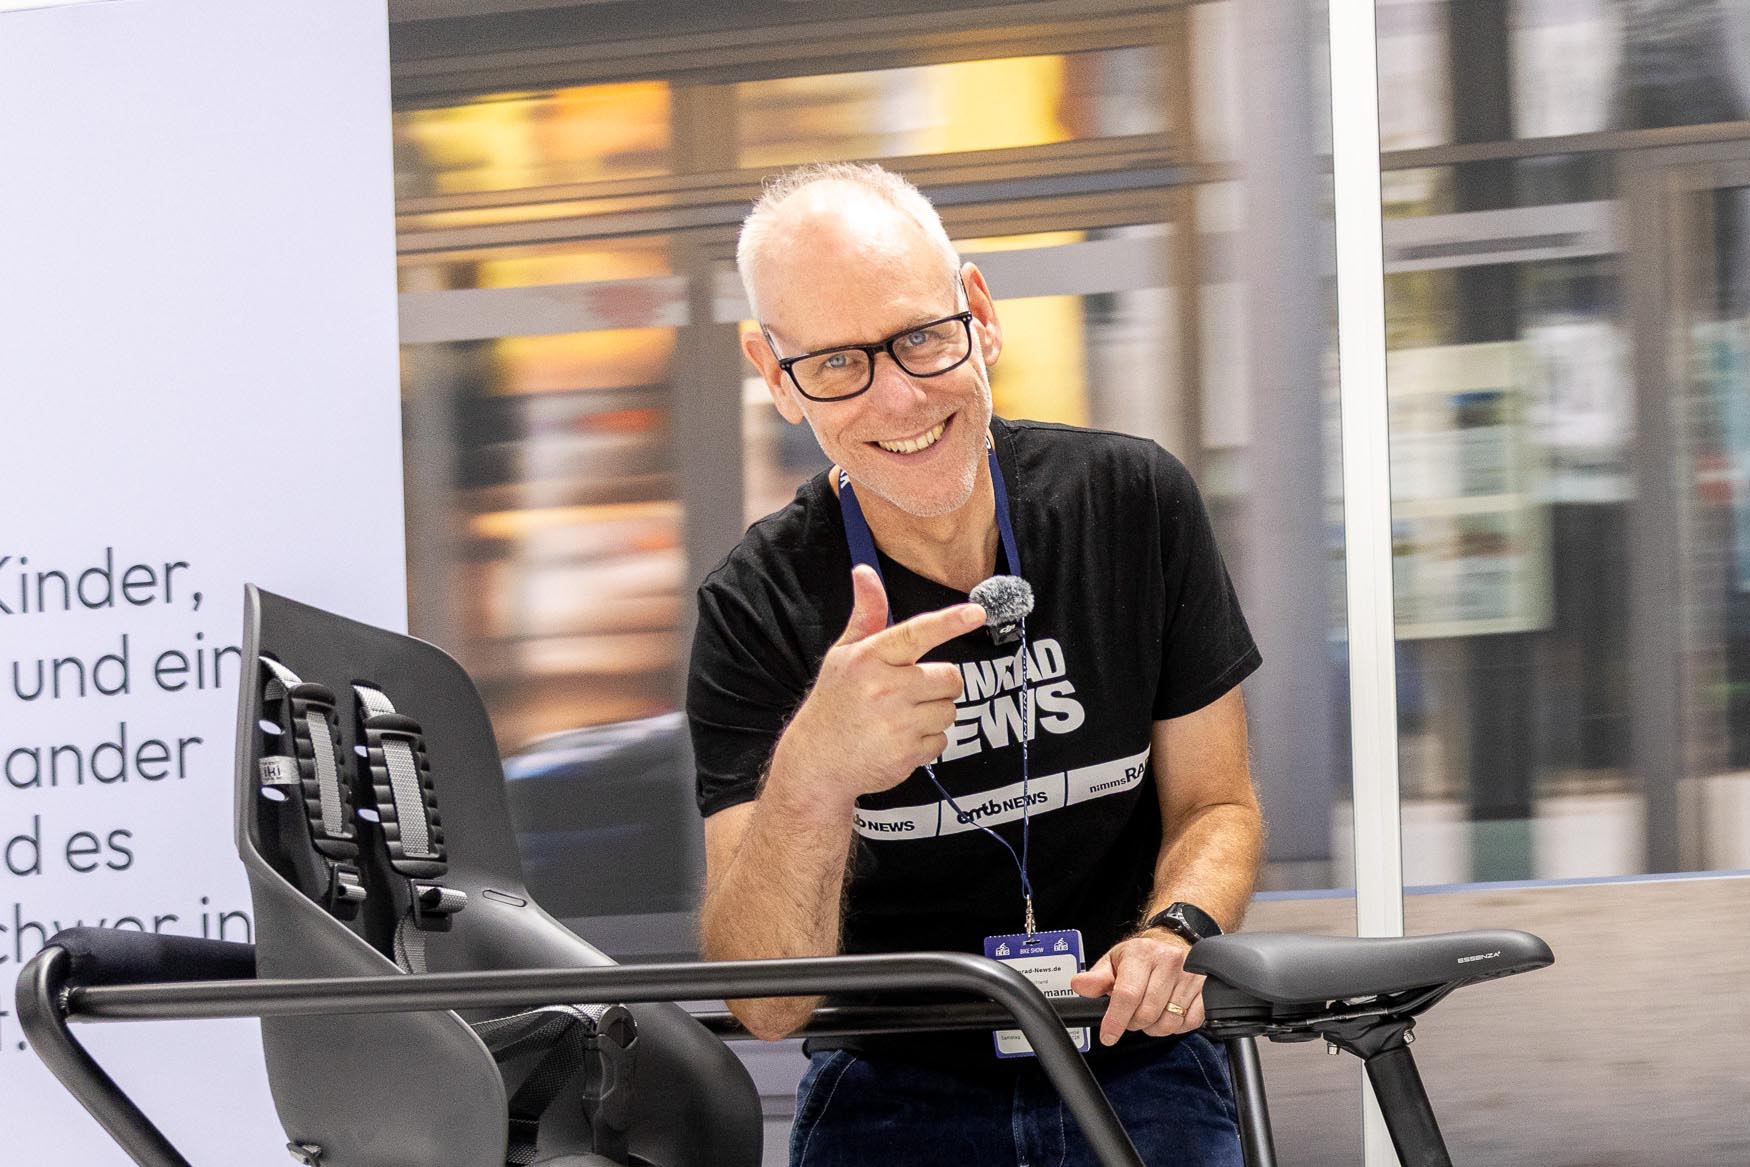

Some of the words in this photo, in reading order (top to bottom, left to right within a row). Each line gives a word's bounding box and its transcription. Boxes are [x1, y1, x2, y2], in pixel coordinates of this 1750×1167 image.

[13, 633, 130, 700] und
[954, 638, 1066, 704] NRAD
[930, 680, 1085, 764] EWS
[5, 721, 204, 789] ander
[1089, 760, 1148, 793] nimmsRA
[868, 820, 915, 832] NEWS
[1002, 791, 1048, 812] NEWS
[66, 829, 135, 873] es
